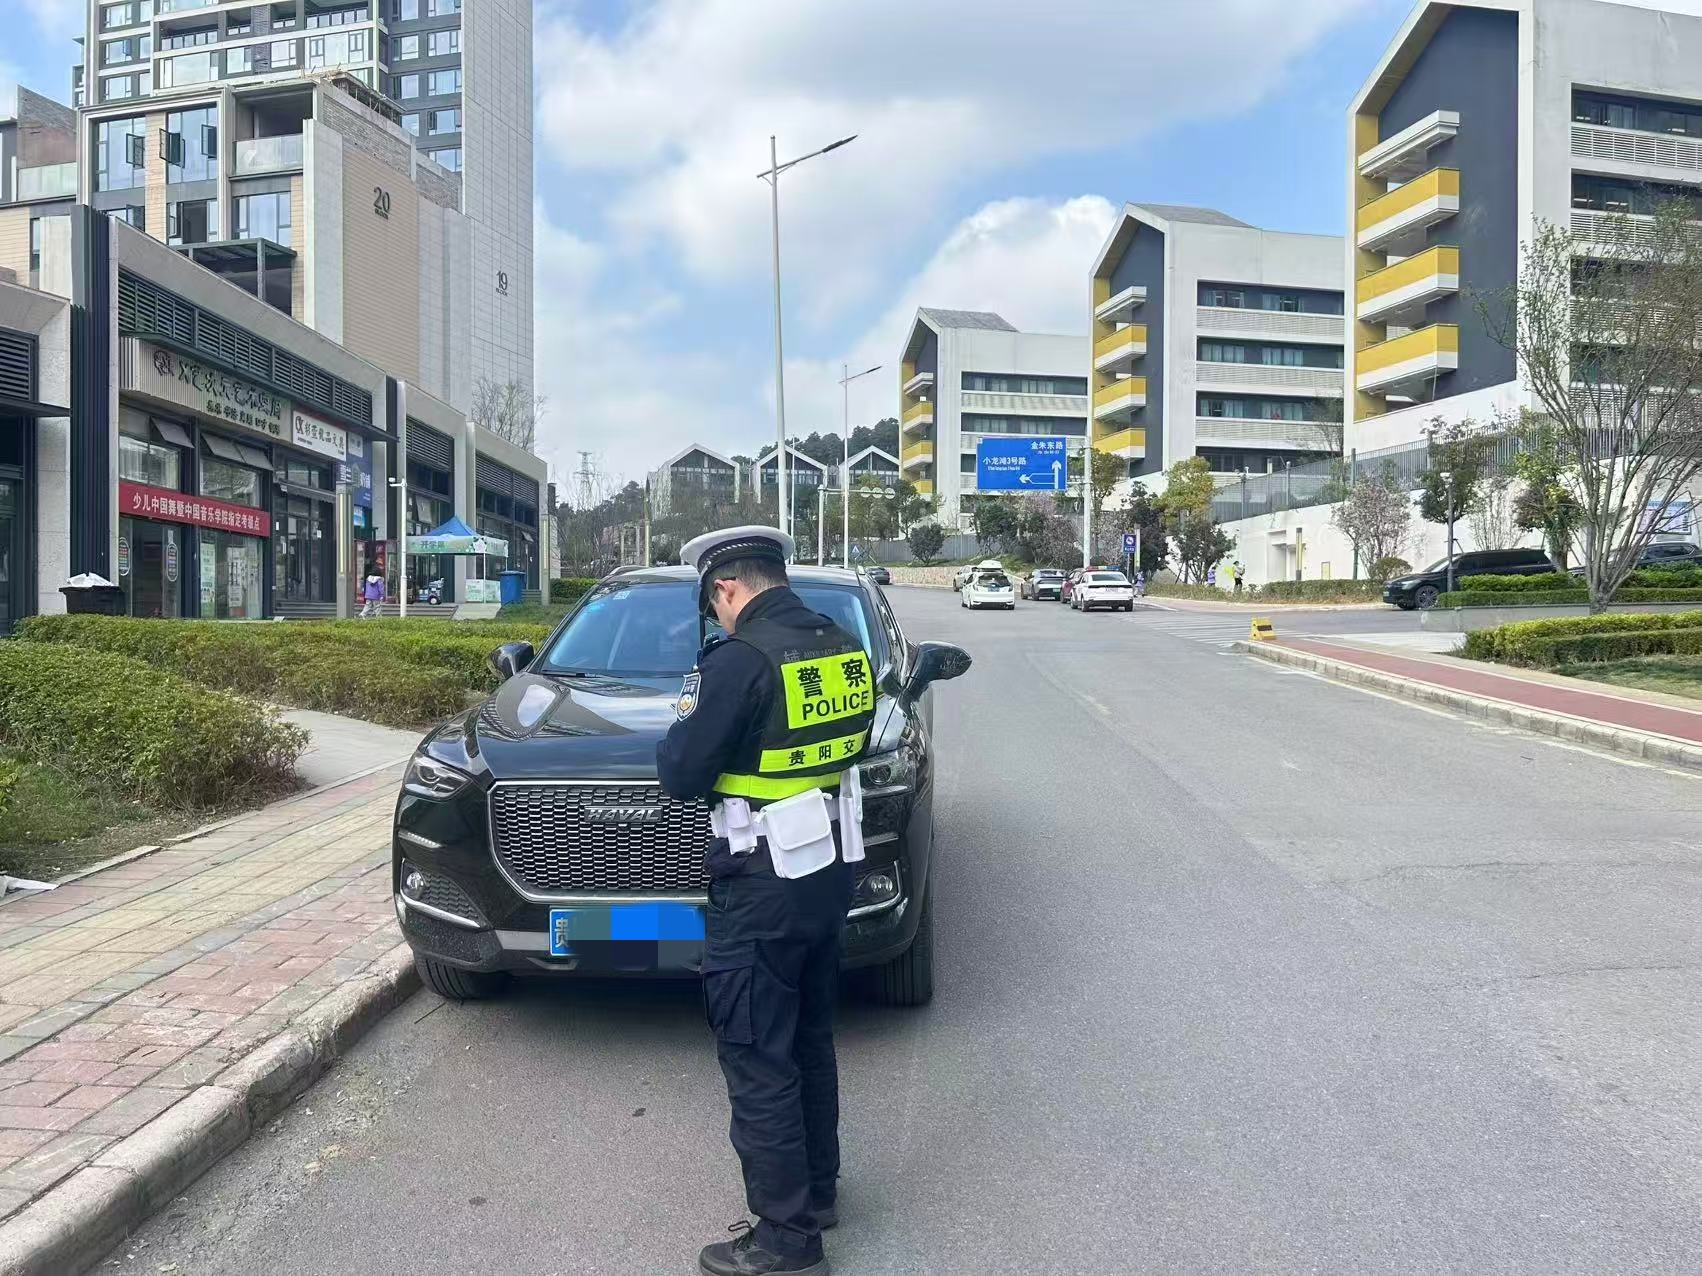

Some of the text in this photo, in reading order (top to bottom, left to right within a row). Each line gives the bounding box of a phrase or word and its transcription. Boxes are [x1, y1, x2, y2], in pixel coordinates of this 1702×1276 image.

[374, 186, 390, 212] 20
[496, 270, 508, 290] 19
[1031, 441, 1063, 450] 金朱东路
[133, 492, 260, 531] 少儿中国舞暨中国音乐学院指定考级点
[796, 658, 867, 698] 警察
[801, 690, 869, 721] POLICE
[788, 738, 856, 767] 贵阳交
[587, 808, 659, 821] HAVAL
